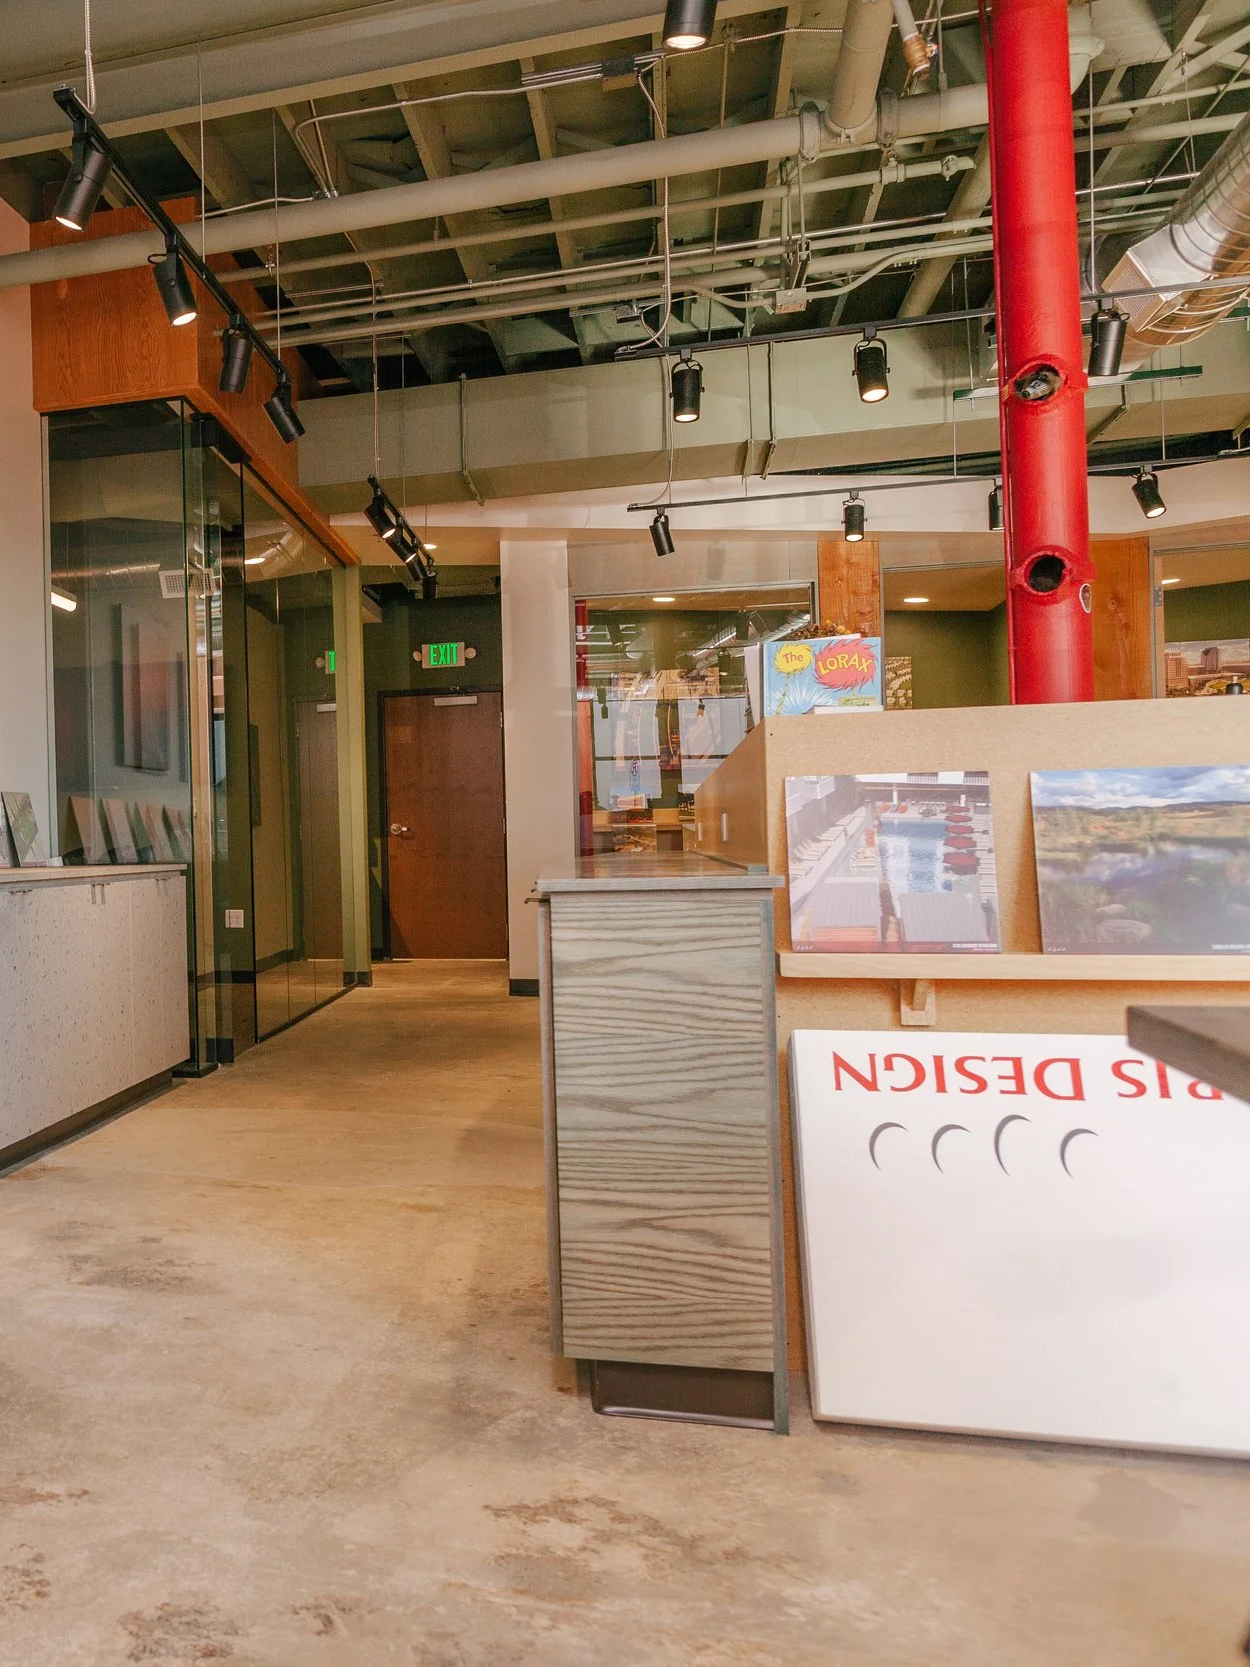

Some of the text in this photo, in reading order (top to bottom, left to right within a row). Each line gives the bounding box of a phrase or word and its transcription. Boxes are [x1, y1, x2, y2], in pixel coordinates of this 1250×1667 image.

[430, 643, 458, 665] EXIT
[782, 651, 804, 664] The
[817, 652, 872, 675] LORAX
[831, 1050, 1087, 1102] DESIGN
